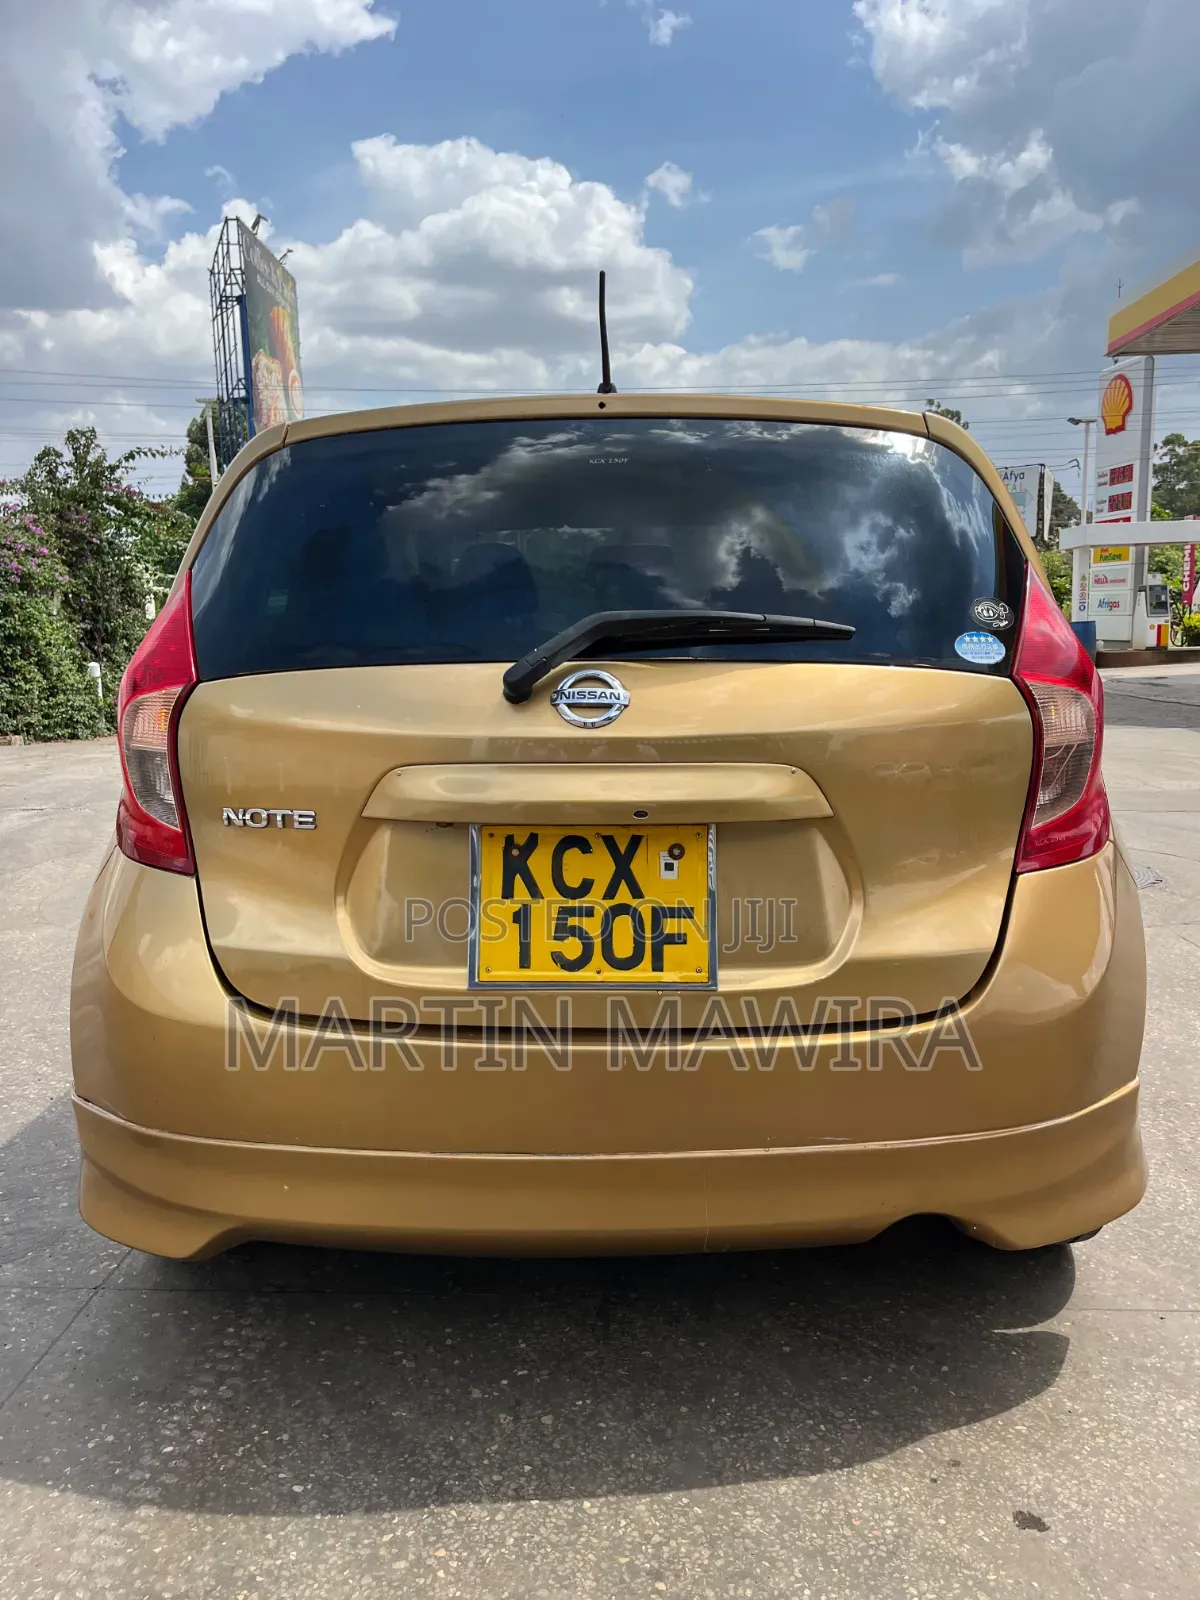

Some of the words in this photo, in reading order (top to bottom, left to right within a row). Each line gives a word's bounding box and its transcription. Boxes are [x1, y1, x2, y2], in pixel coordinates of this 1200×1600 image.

[1003, 470, 1025, 483] Afya
[1098, 597, 1120, 611] Afrigas
[560, 691, 620, 701] NISSAN
[223, 807, 316, 830] NOTE
[501, 832, 645, 900] KCX
[512, 902, 695, 972] 150F
